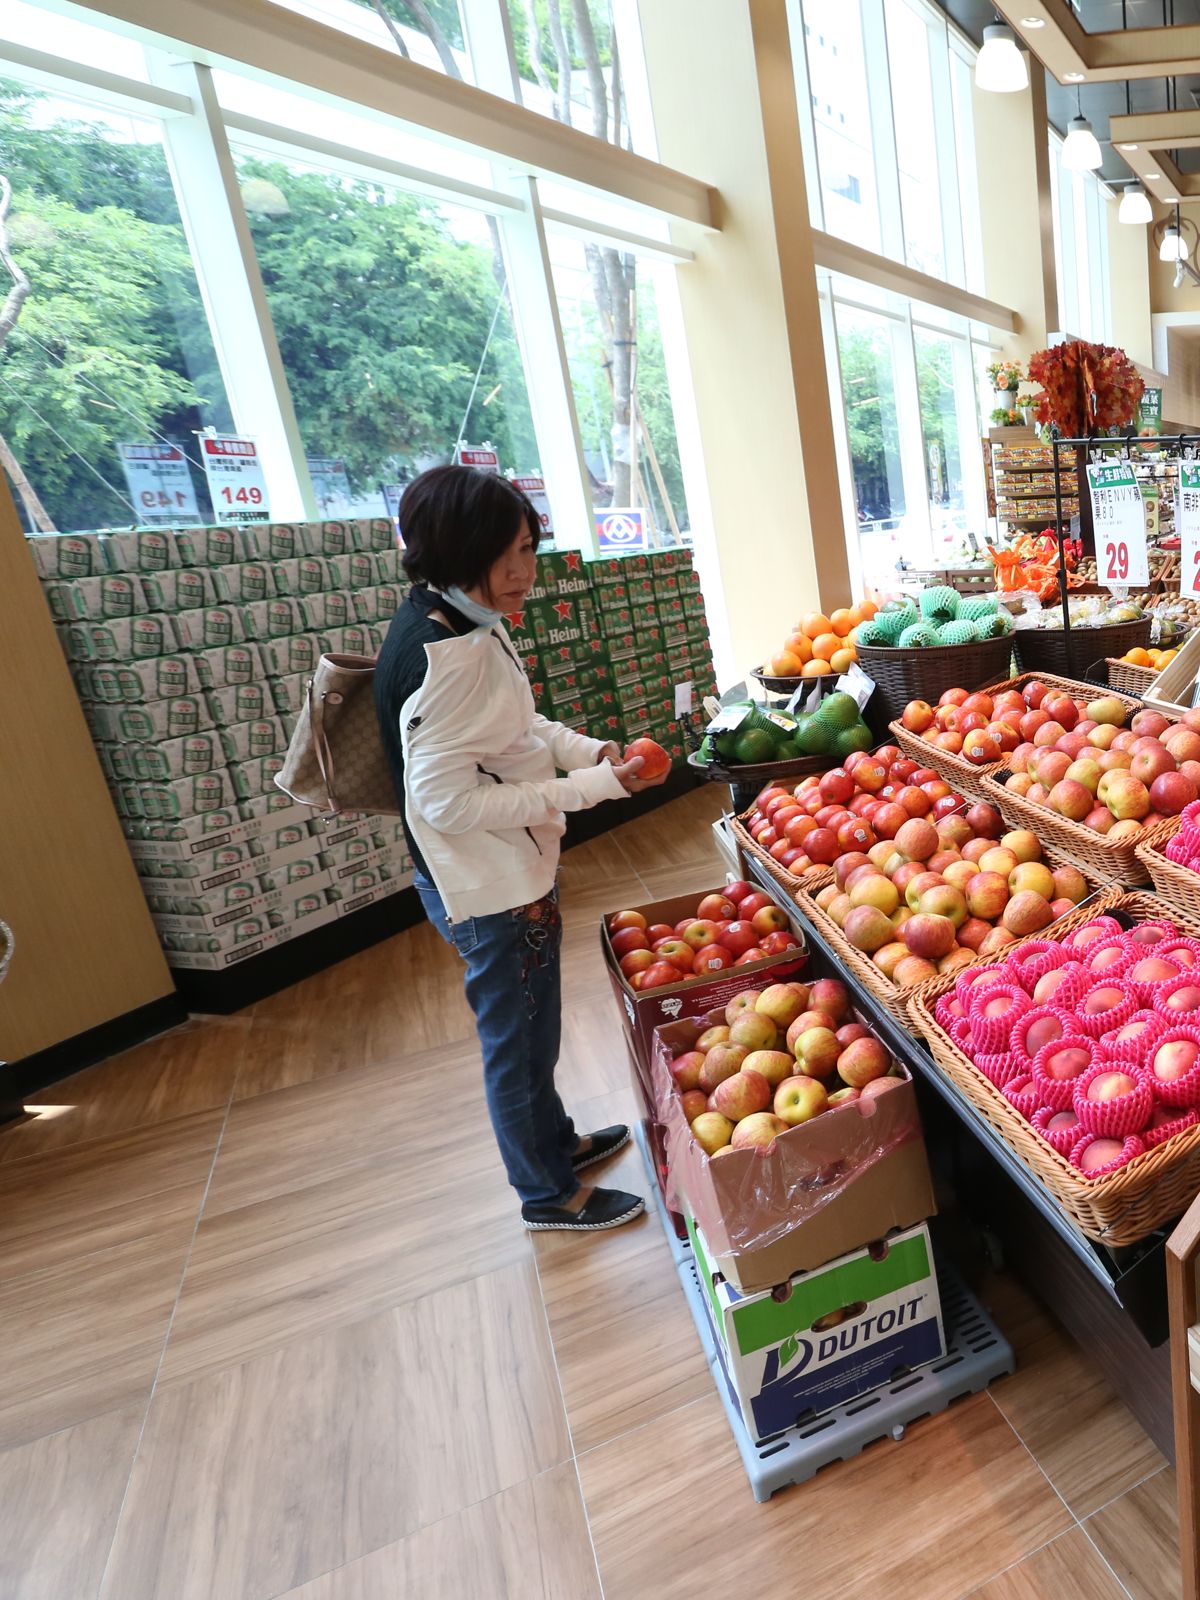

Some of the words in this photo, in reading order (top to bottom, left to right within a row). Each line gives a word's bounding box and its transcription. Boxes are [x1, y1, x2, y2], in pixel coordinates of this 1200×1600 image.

[221, 486, 262, 504] 149
[1105, 542, 1129, 579] 29
[817, 1296, 924, 1362] DUTOIT
